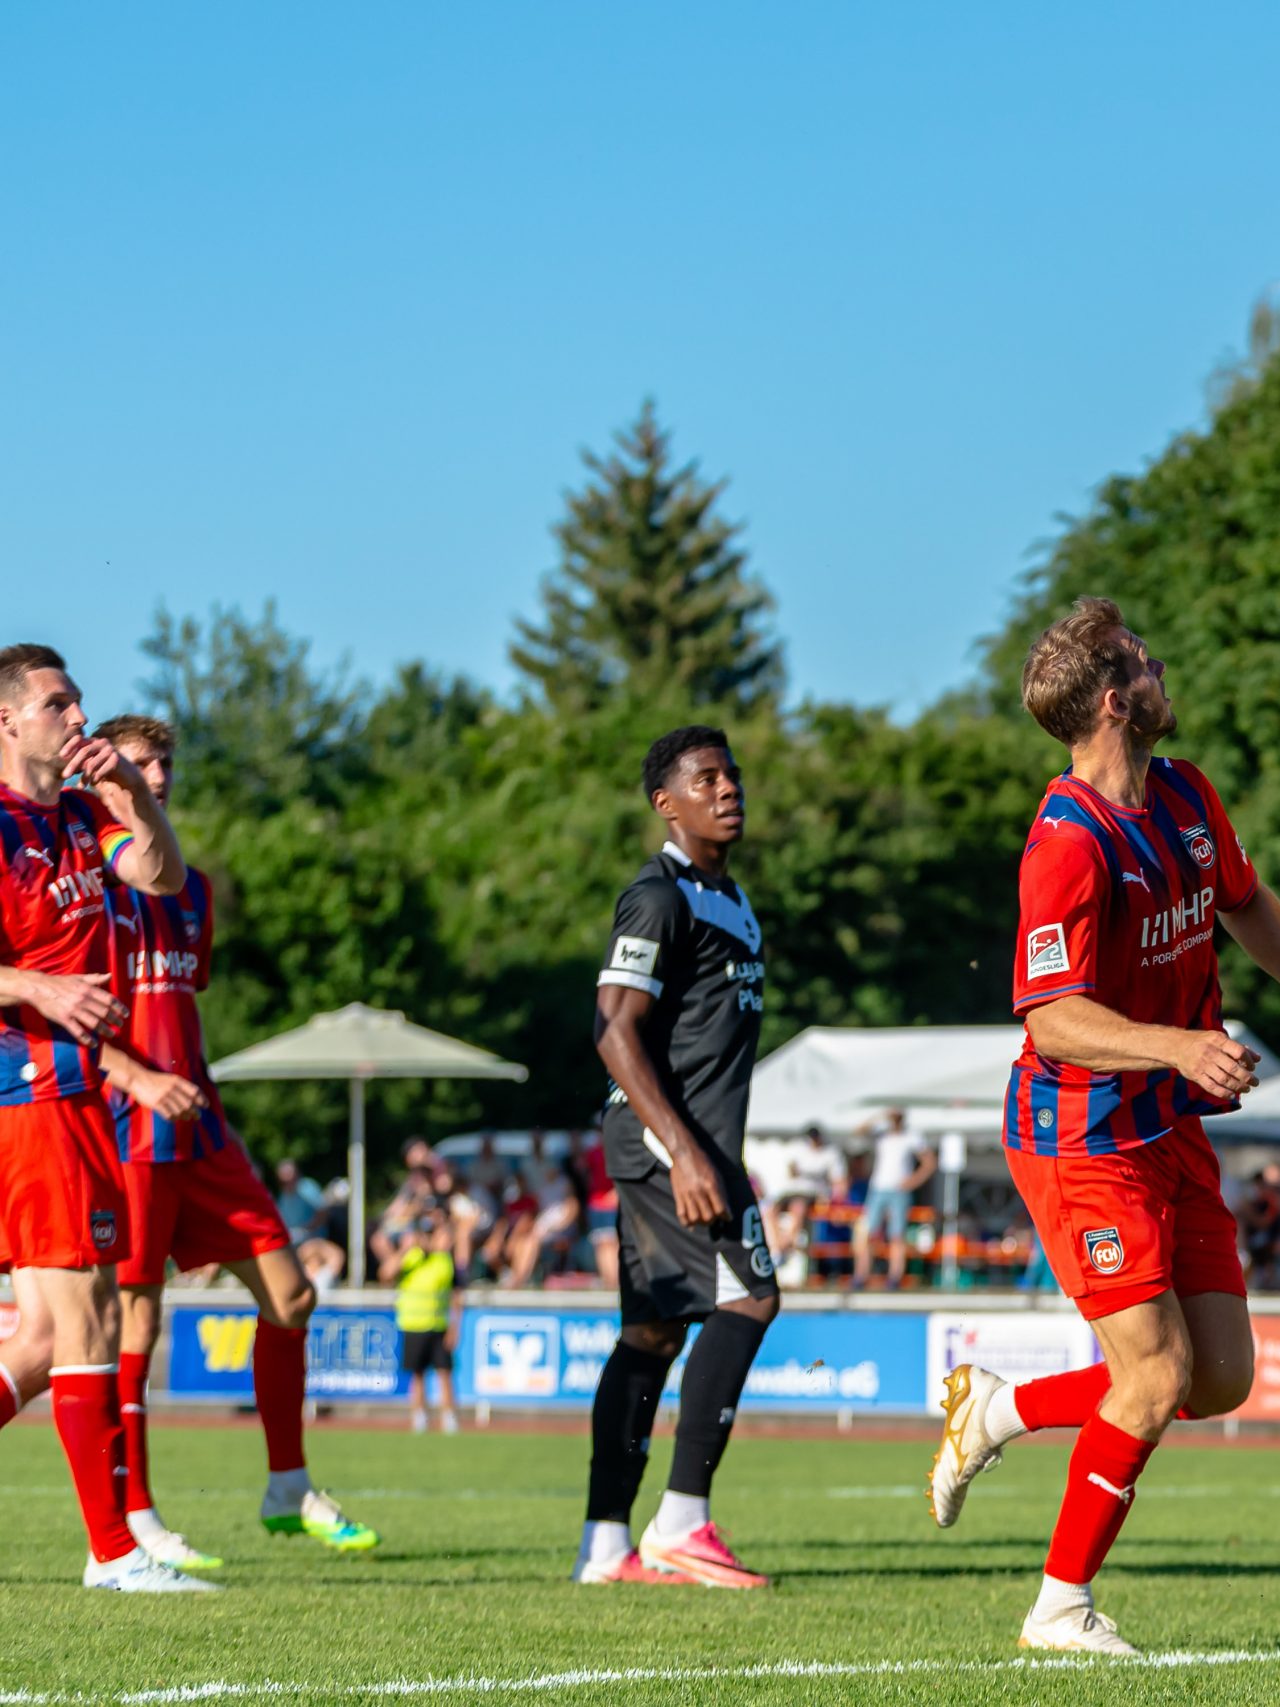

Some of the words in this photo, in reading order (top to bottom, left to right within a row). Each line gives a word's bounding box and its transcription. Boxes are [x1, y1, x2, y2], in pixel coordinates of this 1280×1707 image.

[1193, 843, 1211, 861] FCH
[1048, 943, 1062, 960] 2
[152, 949, 199, 980] MHP
[1096, 1246, 1119, 1265] FCH
